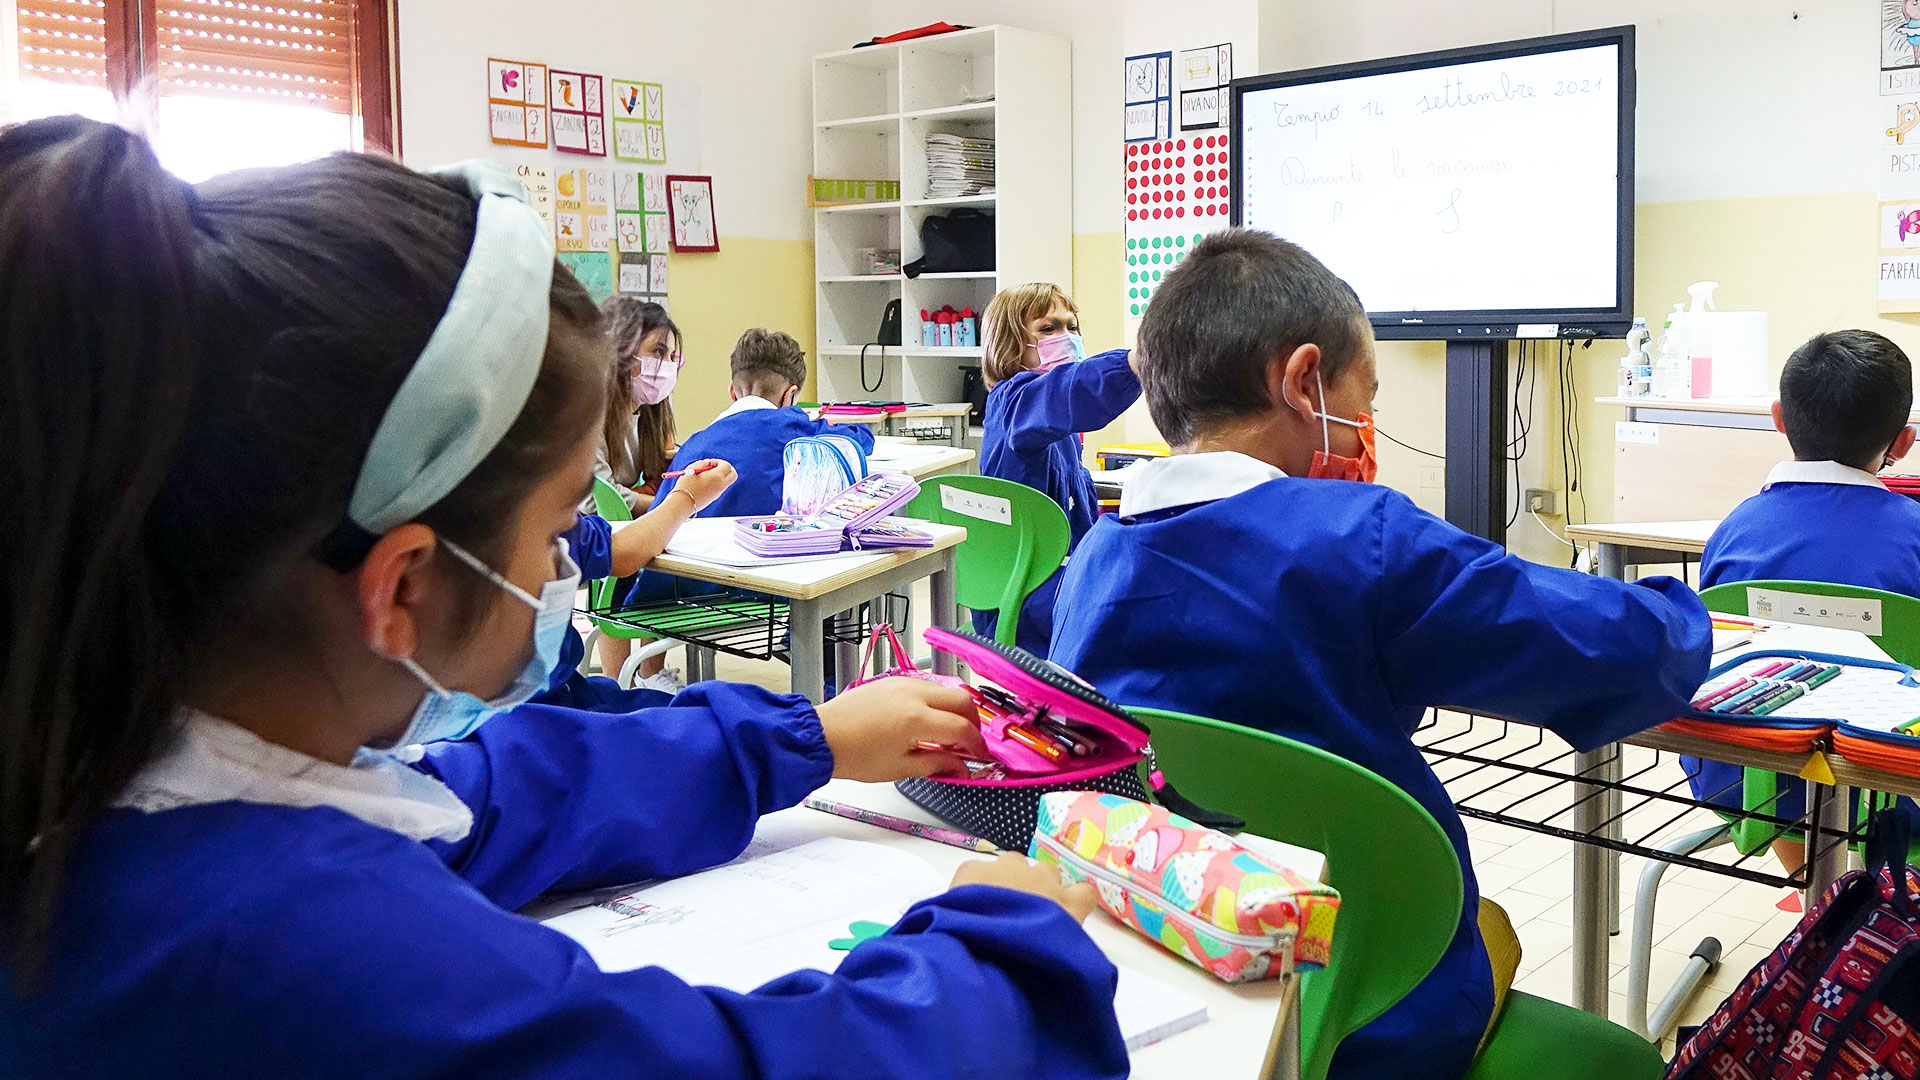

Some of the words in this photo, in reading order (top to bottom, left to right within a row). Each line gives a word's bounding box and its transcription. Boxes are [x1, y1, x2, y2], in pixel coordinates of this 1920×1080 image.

[1159, 59, 1168, 80] N
[1360, 100, 1384, 117] 14
[1415, 71, 1537, 113] settembre
[1553, 76, 1602, 97] 2021
[1183, 95, 1218, 113] DIVANO
[673, 183, 682, 198] H
